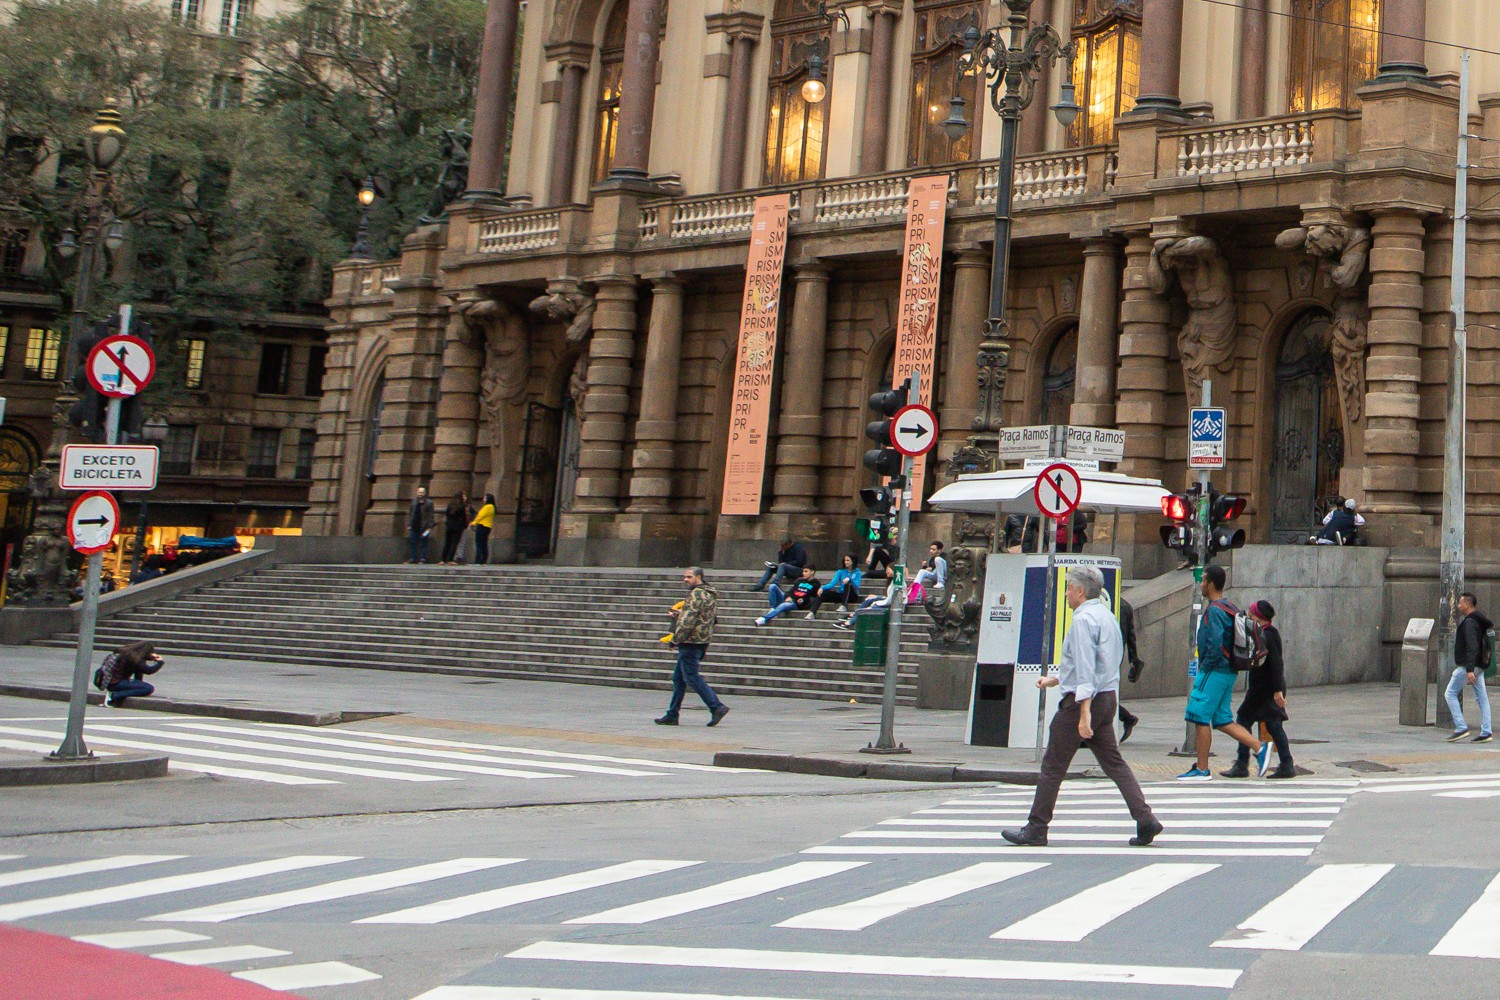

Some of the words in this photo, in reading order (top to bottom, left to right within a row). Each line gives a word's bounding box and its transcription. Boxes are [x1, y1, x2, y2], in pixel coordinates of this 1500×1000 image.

[912, 199, 919, 212] P
[777, 217, 786, 228] M
[911, 213, 924, 226] PR
[769, 231, 785, 244] SM
[910, 228, 925, 241] PRI
[764, 245, 783, 258] ISM
[756, 259, 782, 272] RISM
[905, 287, 937, 301] PRISM
[744, 316, 776, 330] PRISM
[899, 348, 932, 362] PRISM
[898, 363, 931, 377] PRISM
[738, 373, 770, 386] PRISM
[737, 388, 759, 401] PRIS
[735, 403, 751, 416] PRI
[734, 418, 747, 430] PR
[732, 432, 739, 445] P
[1000, 430, 1020, 444] Praça
[1023, 428, 1049, 441] Ramos
[1068, 428, 1091, 444] Praça
[1094, 430, 1124, 444] Ramos
[82, 456, 136, 466] EXCETO
[73, 469, 142, 479] BICICLETA
